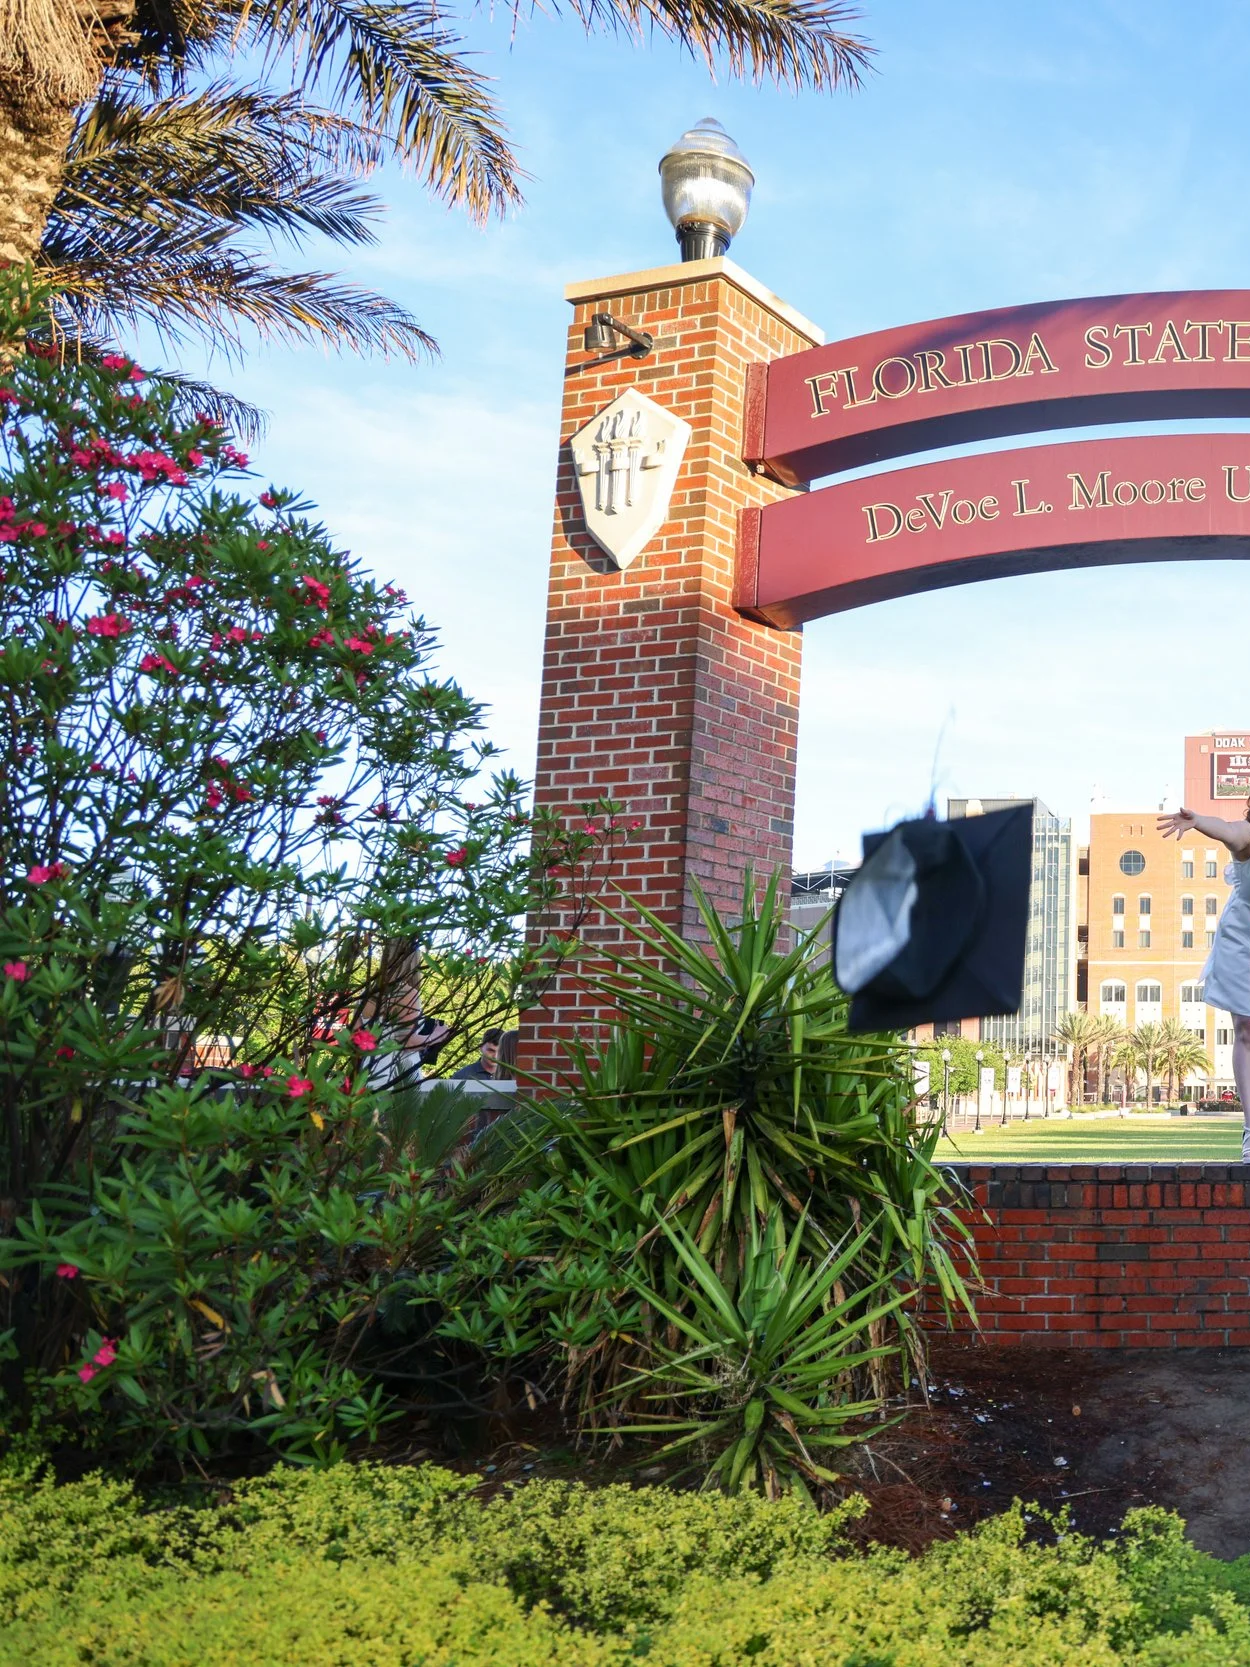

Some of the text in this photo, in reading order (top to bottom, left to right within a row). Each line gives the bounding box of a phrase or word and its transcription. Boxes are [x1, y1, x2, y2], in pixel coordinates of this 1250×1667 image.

[805, 333, 1059, 418] FLORIDA
[862, 489, 1000, 544] DeVoe
[1011, 479, 1053, 516] L.
[1067, 471, 1206, 510] Moore
[1215, 738, 1246, 748] DOAK
